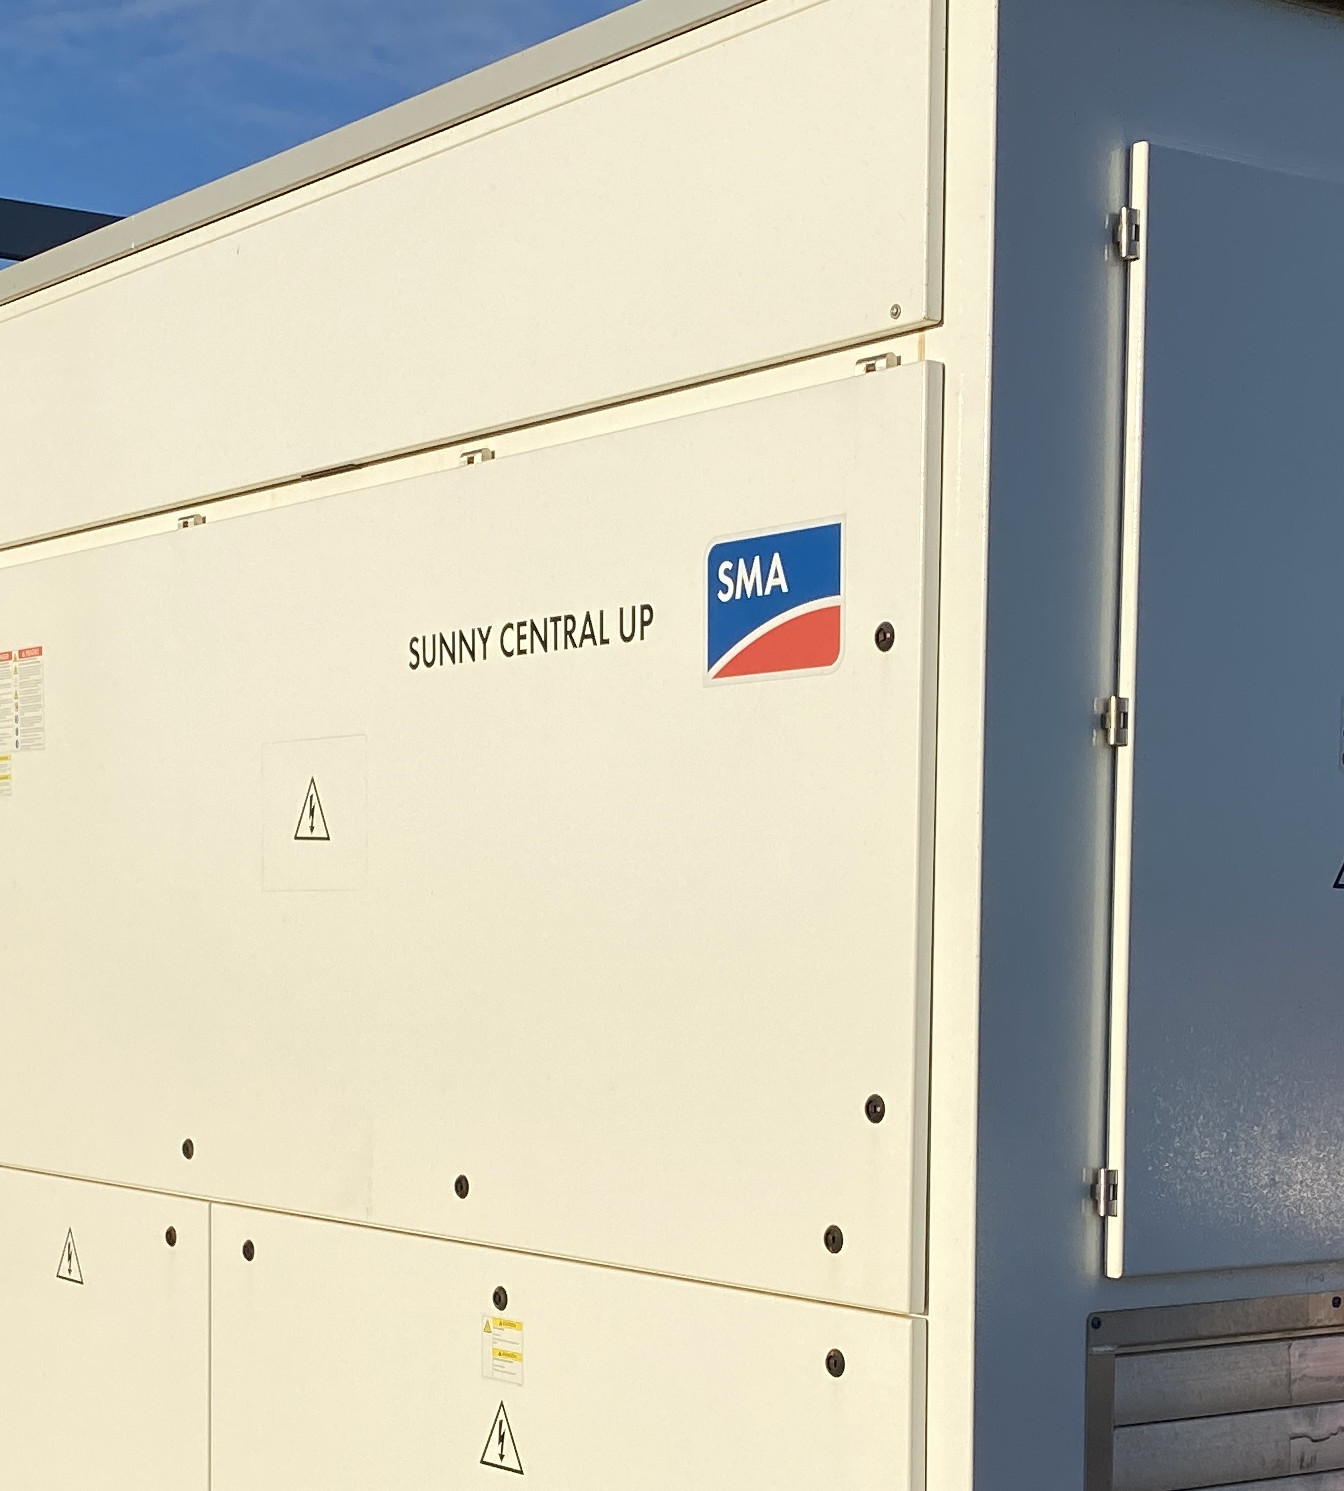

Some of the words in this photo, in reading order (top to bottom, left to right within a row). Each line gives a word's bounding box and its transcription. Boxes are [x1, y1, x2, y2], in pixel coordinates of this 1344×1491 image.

[717, 552, 789, 603] SMA
[408, 625, 493, 671] SUNNY
[499, 609, 610, 658] CENTRAL
[619, 603, 654, 643] UP
